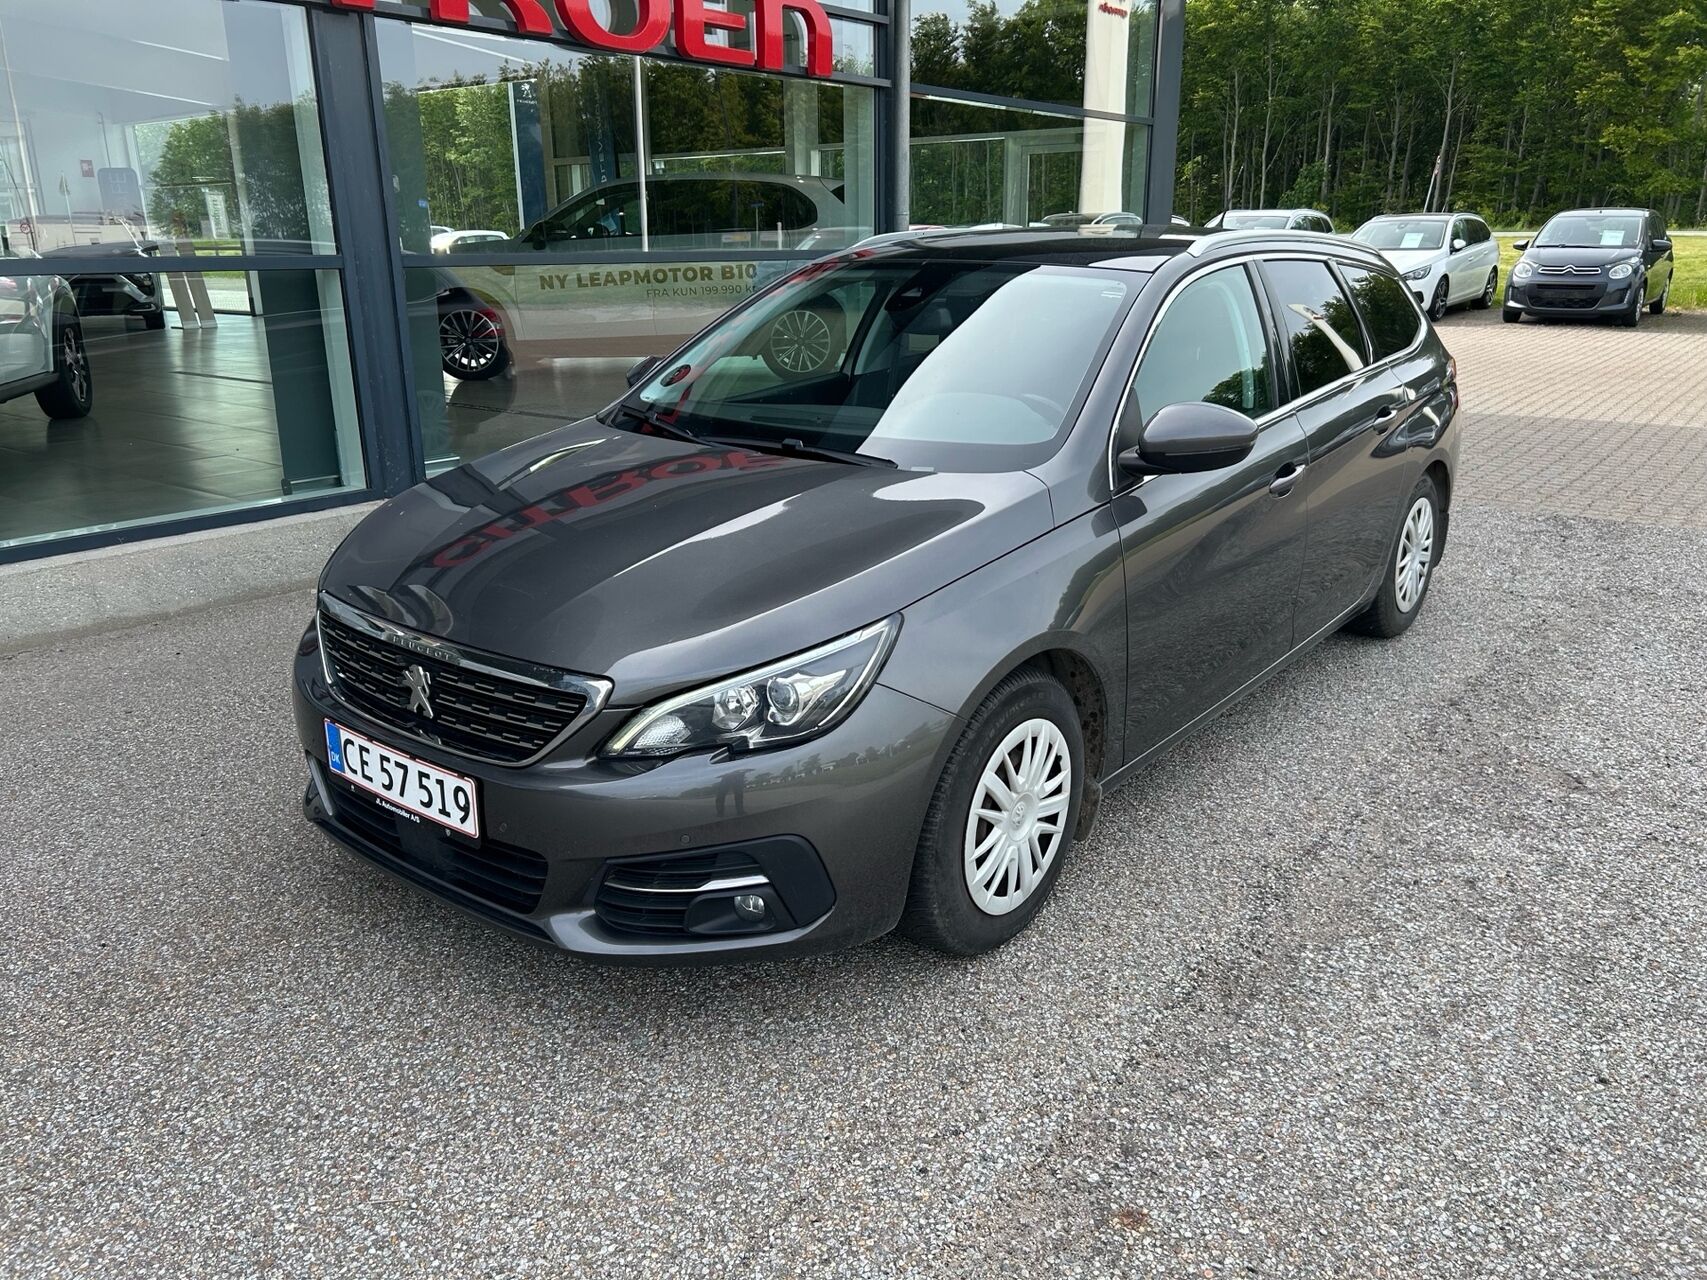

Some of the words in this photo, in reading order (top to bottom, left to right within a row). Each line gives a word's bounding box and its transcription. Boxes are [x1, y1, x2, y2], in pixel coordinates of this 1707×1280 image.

[539, 273, 569, 290] NY
[576, 264, 713, 289] LEAPMOTOR
[720, 263, 757, 281] B10
[646, 287, 669, 298] FRA
[672, 285, 697, 297] KUN
[700, 284, 742, 296] 199.990
[393, 635, 449, 660] PEUGEOT
[331, 751, 340, 763] DK
[343, 738, 373, 783] CE
[379, 753, 409, 798] 57
[417, 769, 471, 824] 519
